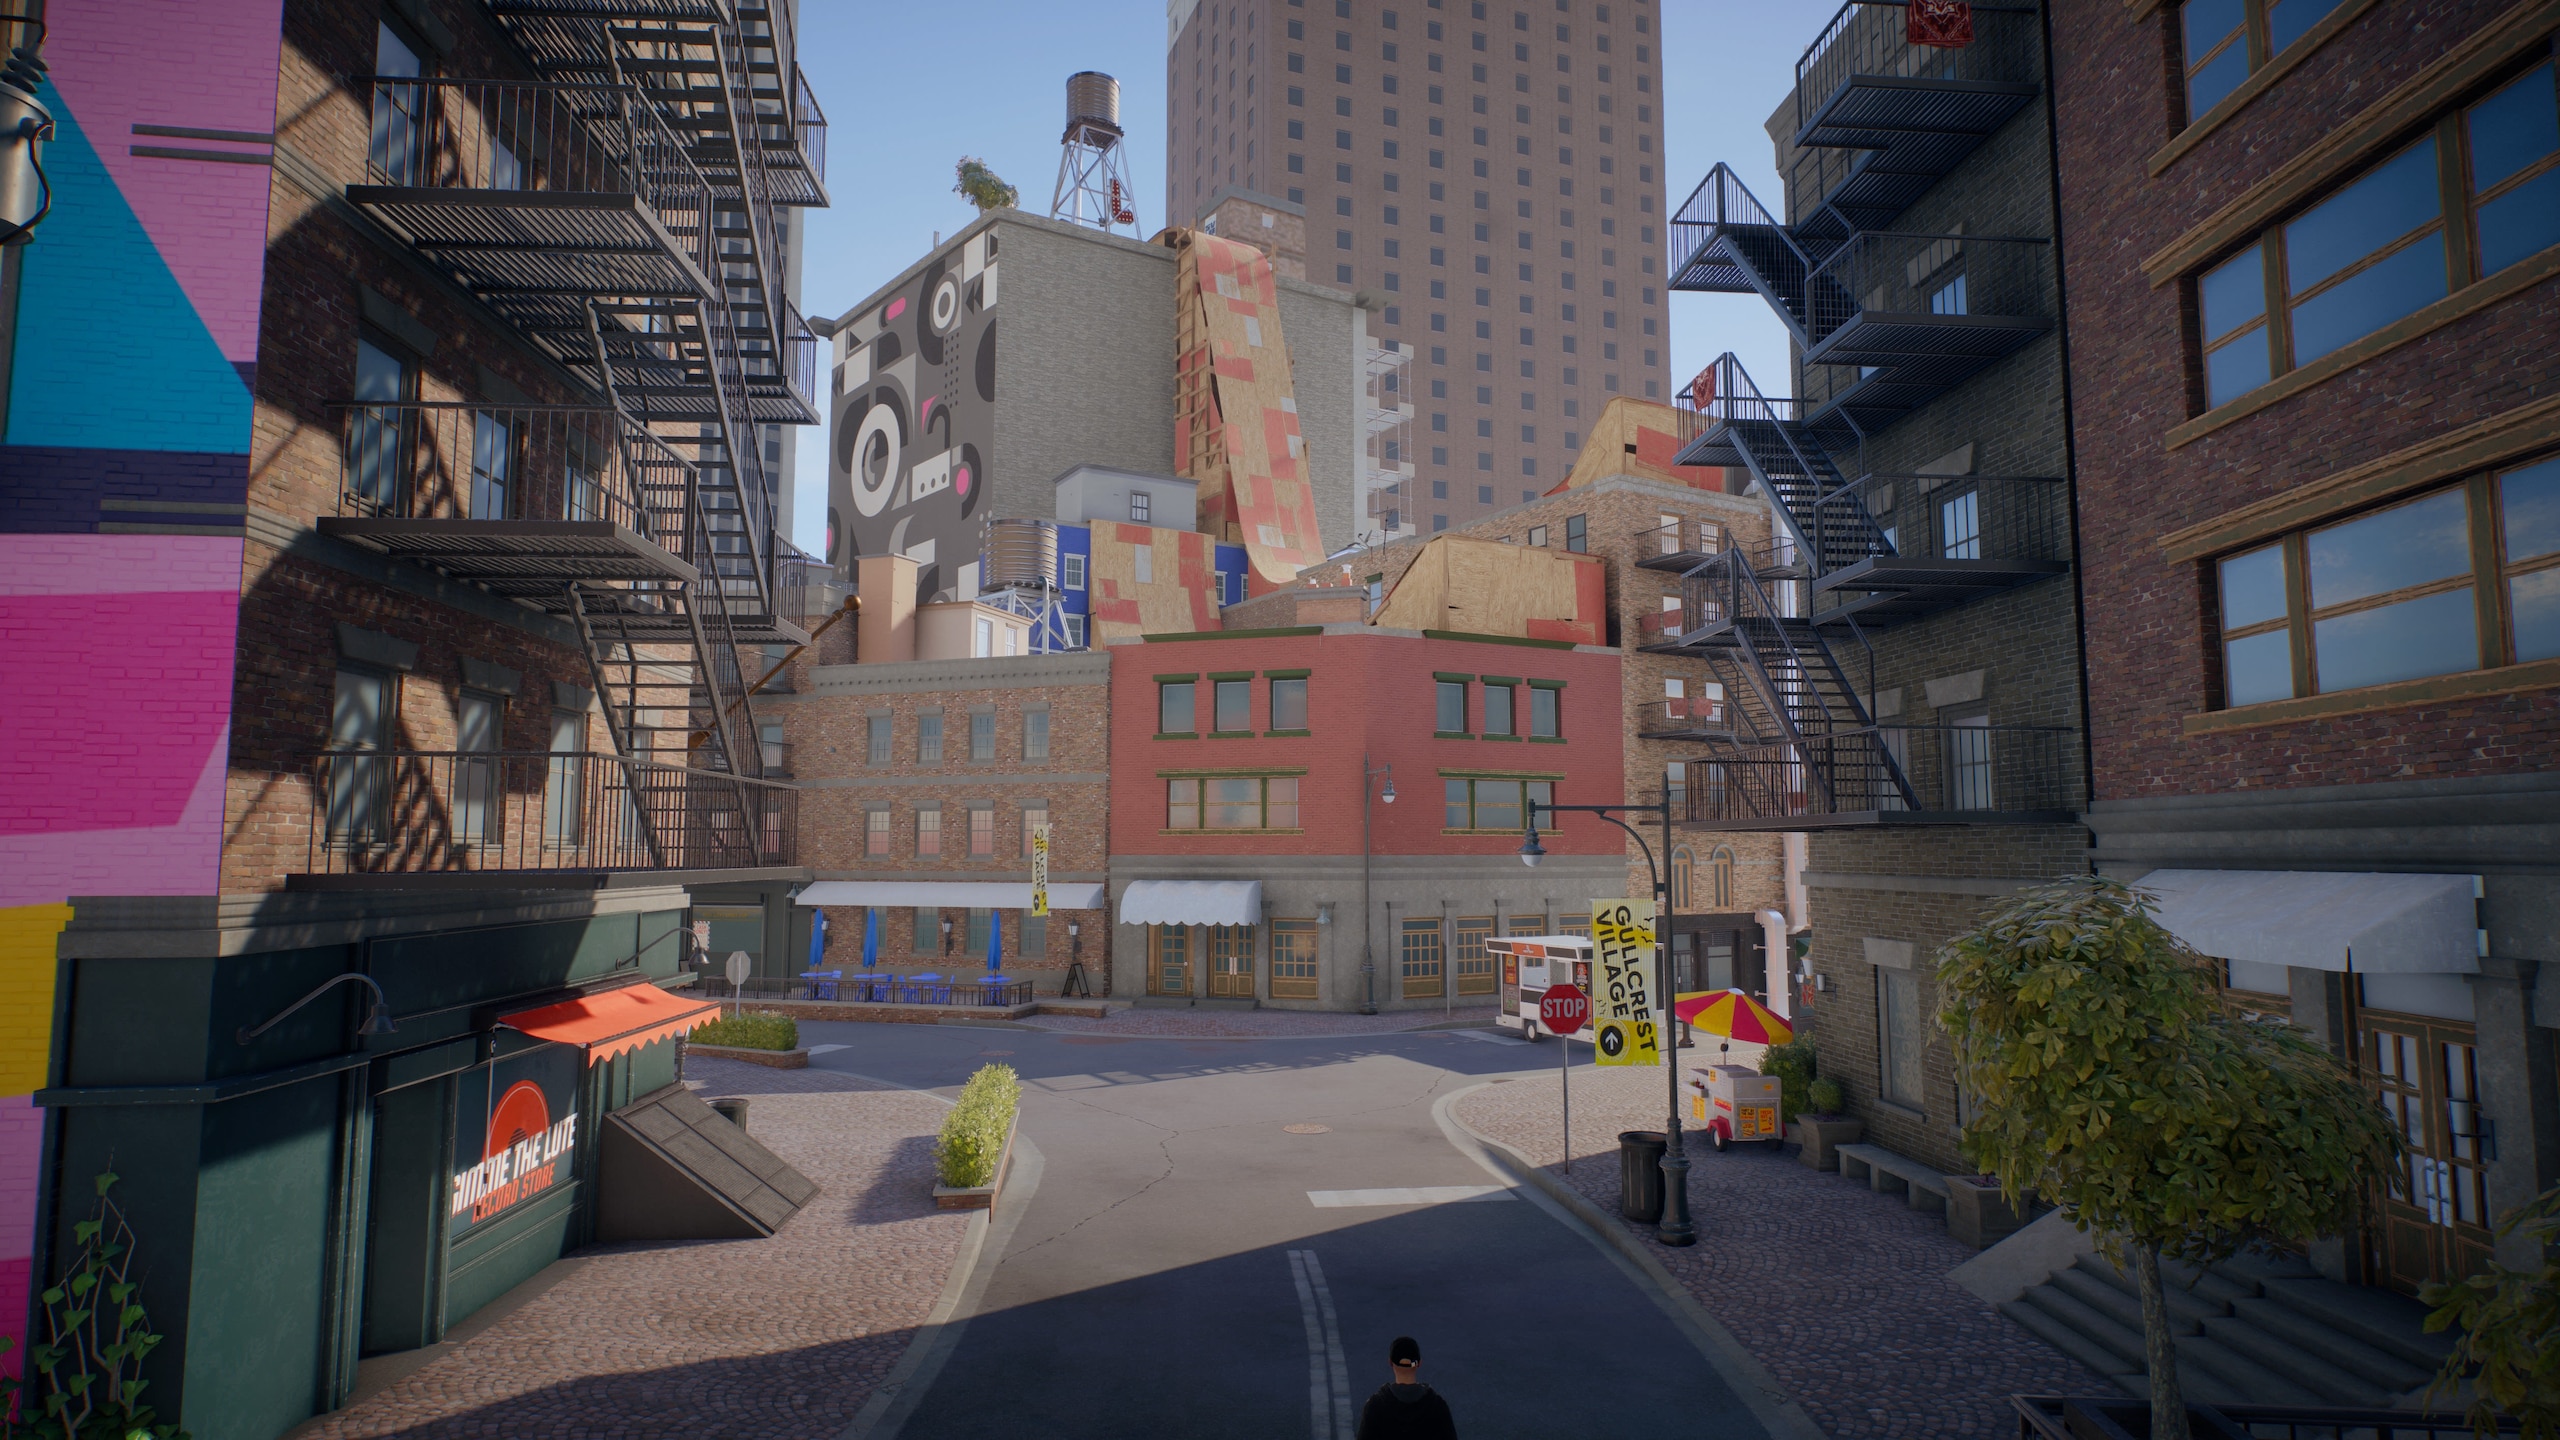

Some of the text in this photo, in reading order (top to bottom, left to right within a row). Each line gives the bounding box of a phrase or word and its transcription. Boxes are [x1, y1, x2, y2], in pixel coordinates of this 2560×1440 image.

[1596, 908, 1629, 1018] VILLAGE
[1615, 905, 1656, 1052] GULLCREST
[1543, 998, 1585, 1018] STOP
[513, 1131, 544, 1179] THE
[543, 1112, 579, 1162] LUTE
[472, 1162, 556, 1224] RECORD STORE
